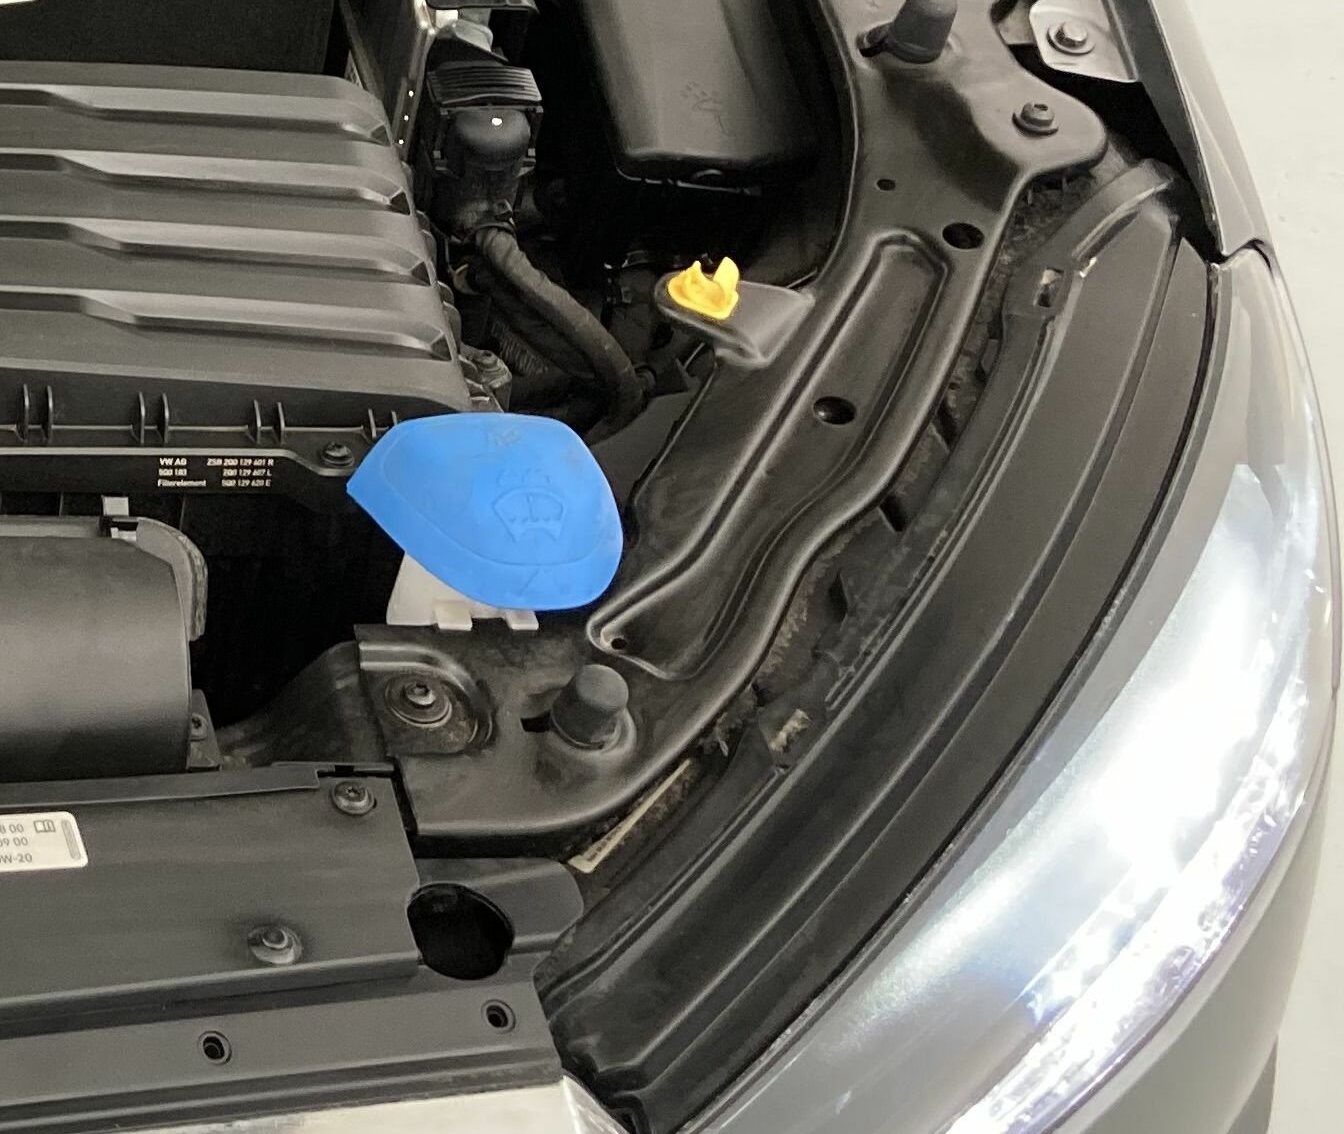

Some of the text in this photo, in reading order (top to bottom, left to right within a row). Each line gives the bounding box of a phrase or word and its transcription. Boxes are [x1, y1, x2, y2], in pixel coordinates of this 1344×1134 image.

[160, 458, 187, 466] VW AG
[240, 458, 252, 466] 129
[267, 468, 272, 476] L
[9, 824, 24, 833] 00
[13, 837, 28, 846] 00
